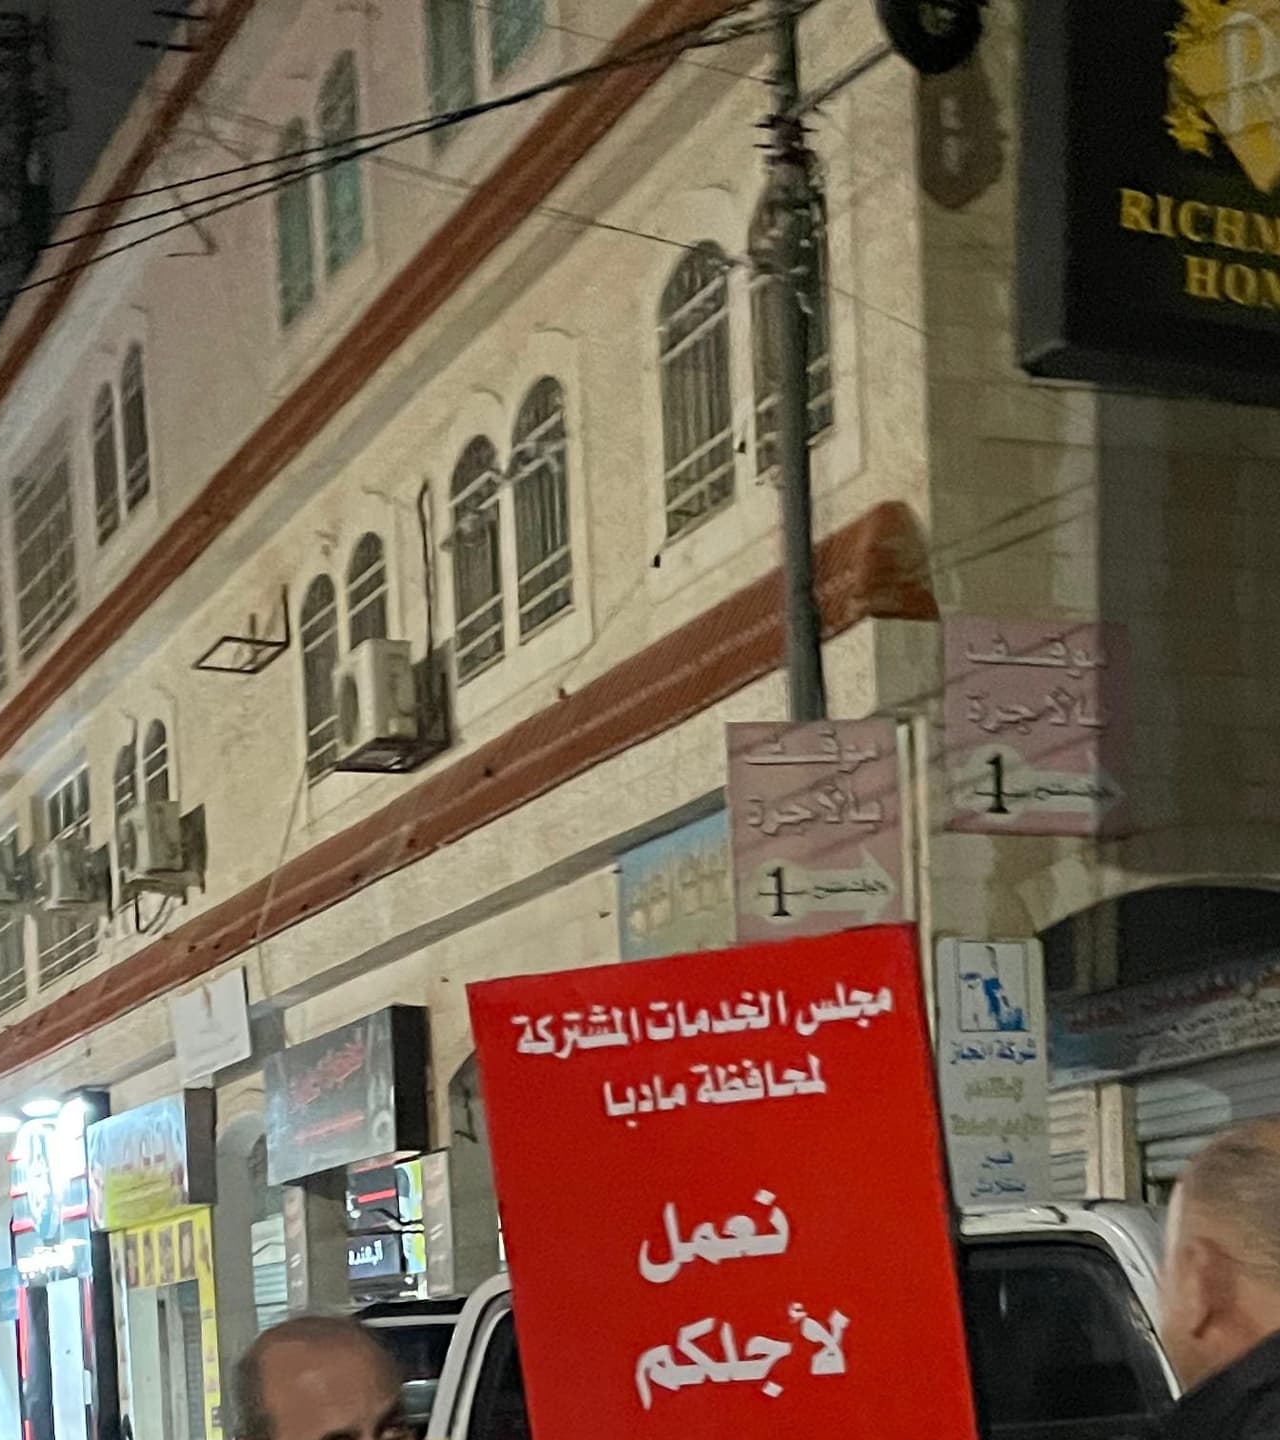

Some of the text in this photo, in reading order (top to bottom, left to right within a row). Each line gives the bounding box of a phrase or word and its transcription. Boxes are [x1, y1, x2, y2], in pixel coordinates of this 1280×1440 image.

[510, 982, 894, 1059] مجلس الخدمات المشتركة
[603, 1053, 827, 1128] لمحافظة مادبا
[638, 1188, 790, 1284] نعمل
[635, 1302, 851, 1411] لأجلكم
